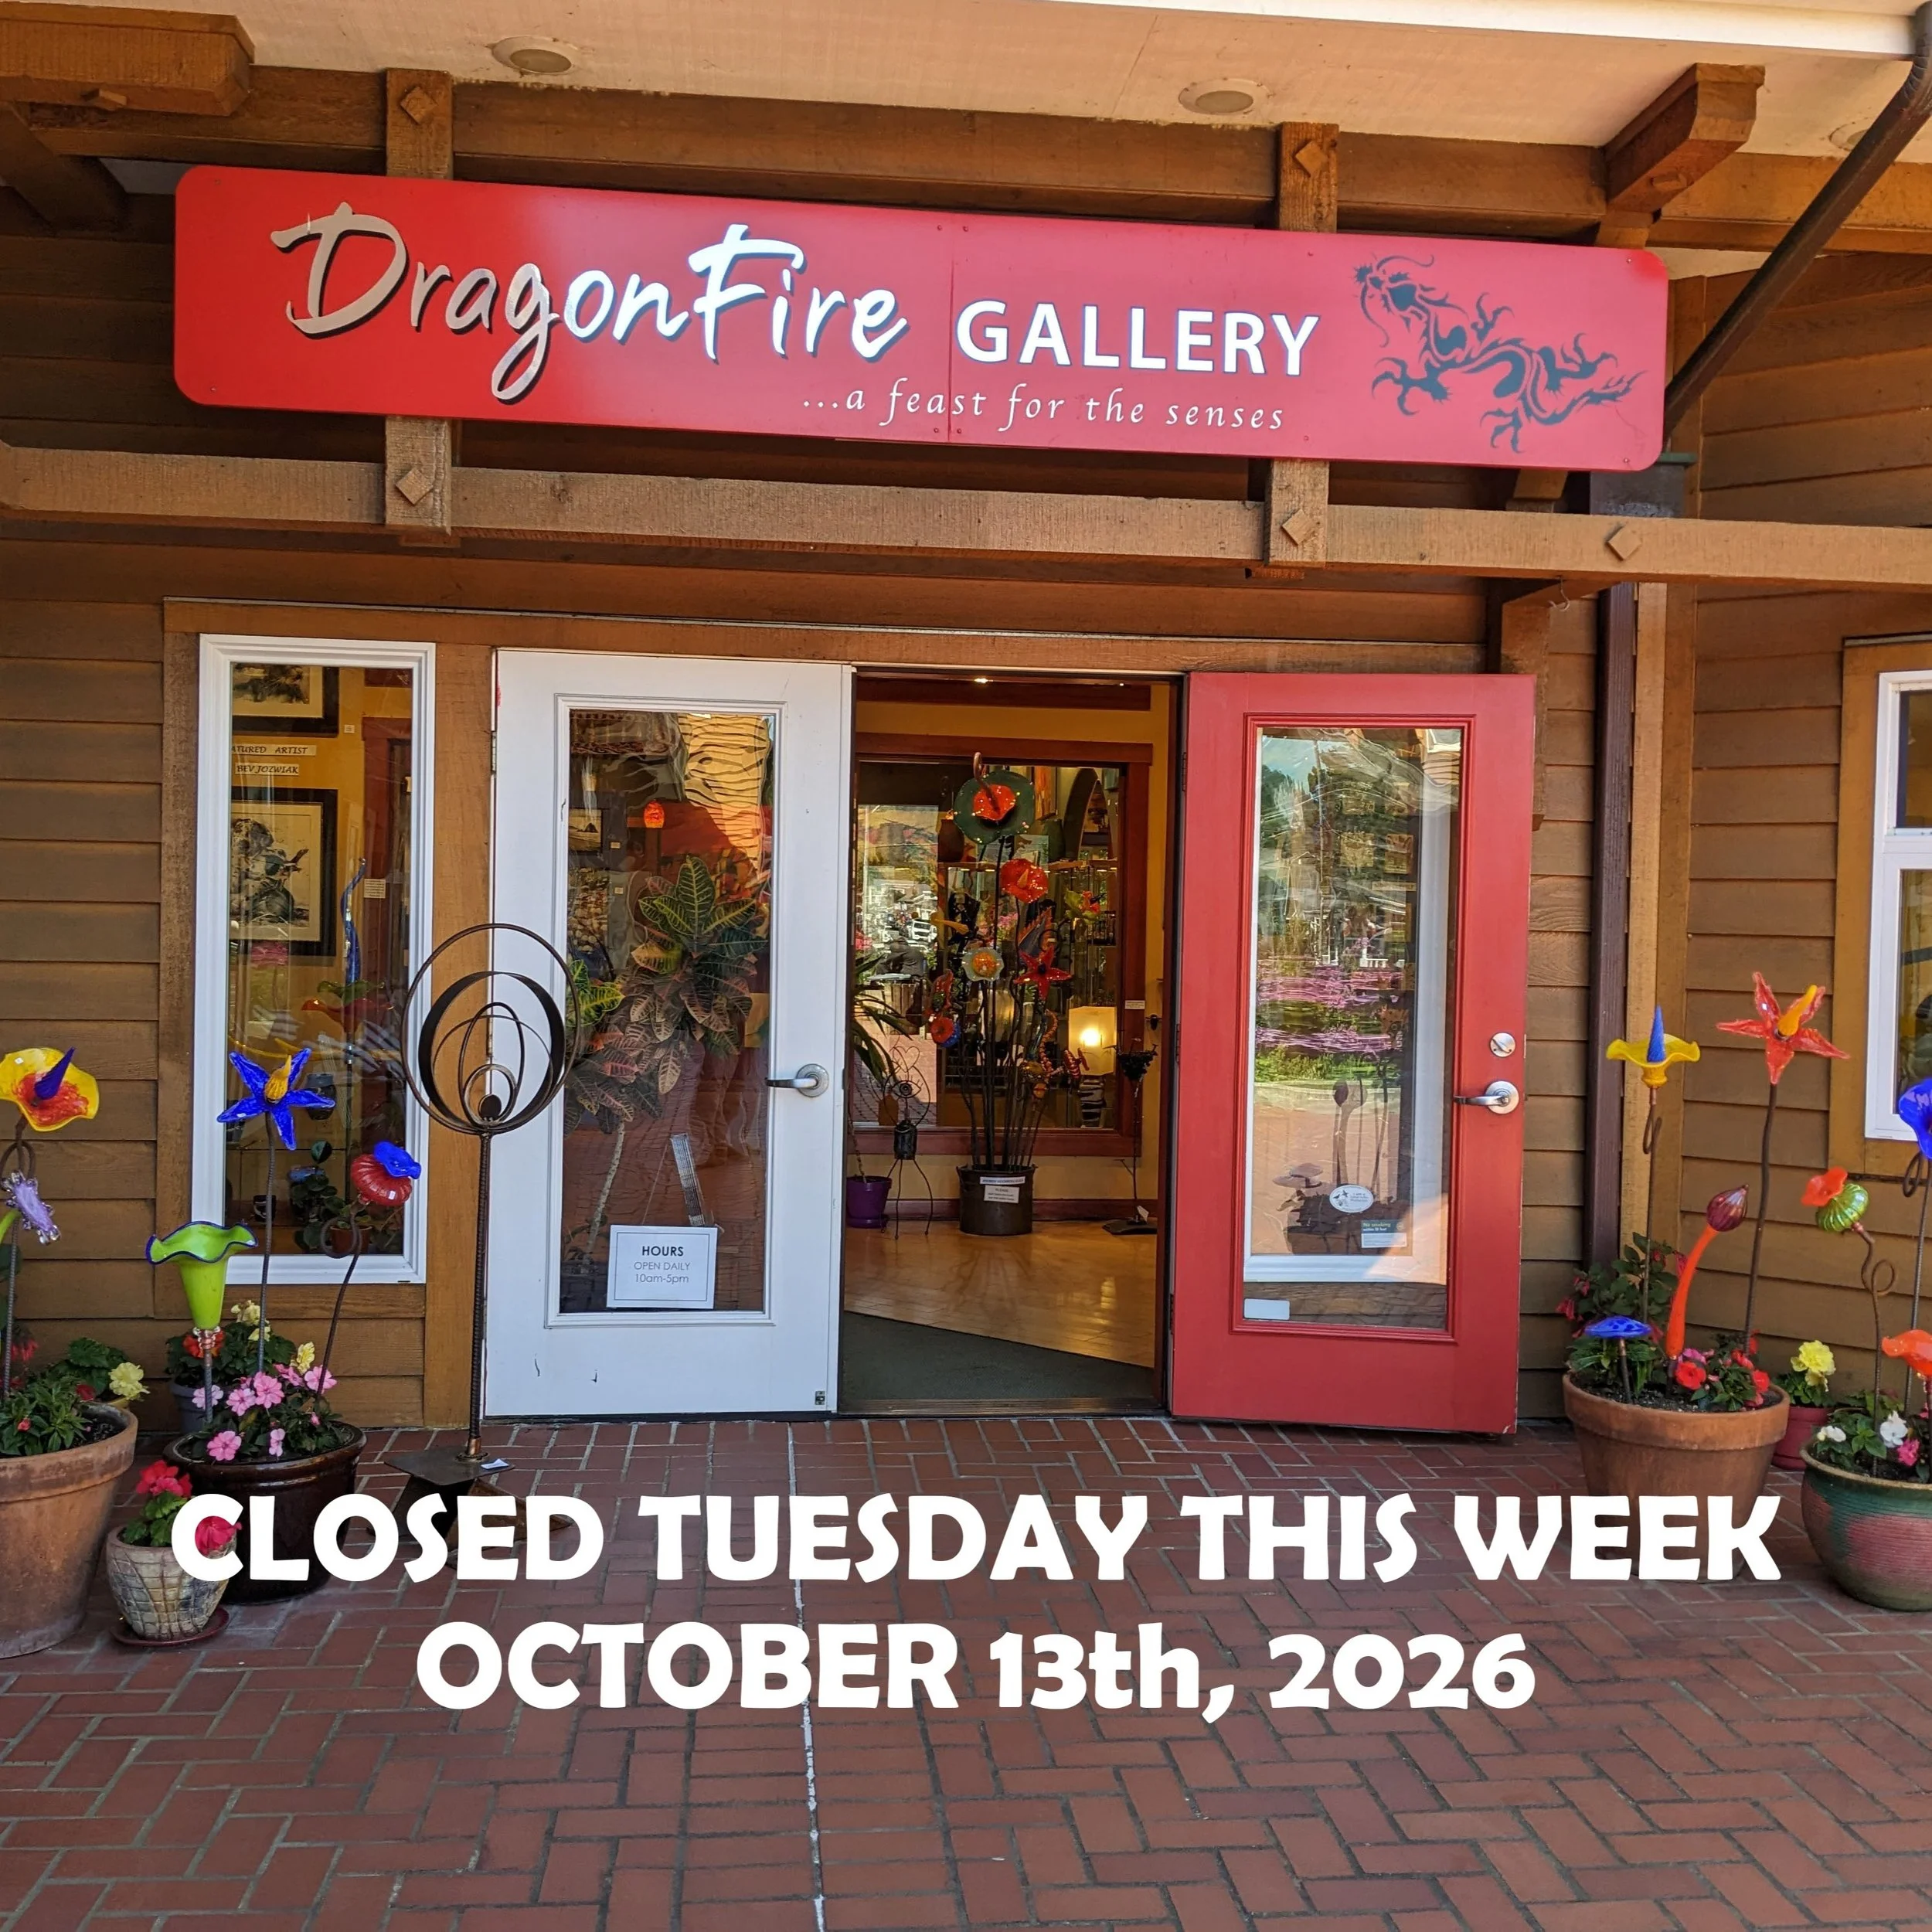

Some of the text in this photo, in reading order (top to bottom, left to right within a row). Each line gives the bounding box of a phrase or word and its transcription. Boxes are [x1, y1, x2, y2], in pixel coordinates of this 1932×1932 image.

[270, 202, 1319, 405] DragonFire GALLERY
[879, 378, 987, 427] feast
[998, 383, 1065, 432] for
[1085, 387, 1144, 423] the
[1165, 403, 1284, 430] senses
[275, 746, 308, 754] ARTIST
[641, 1245, 685, 1257] HOURS
[634, 1261, 691, 1270] OPEN DAILY
[635, 1274, 689, 1284] 10am-5pm
